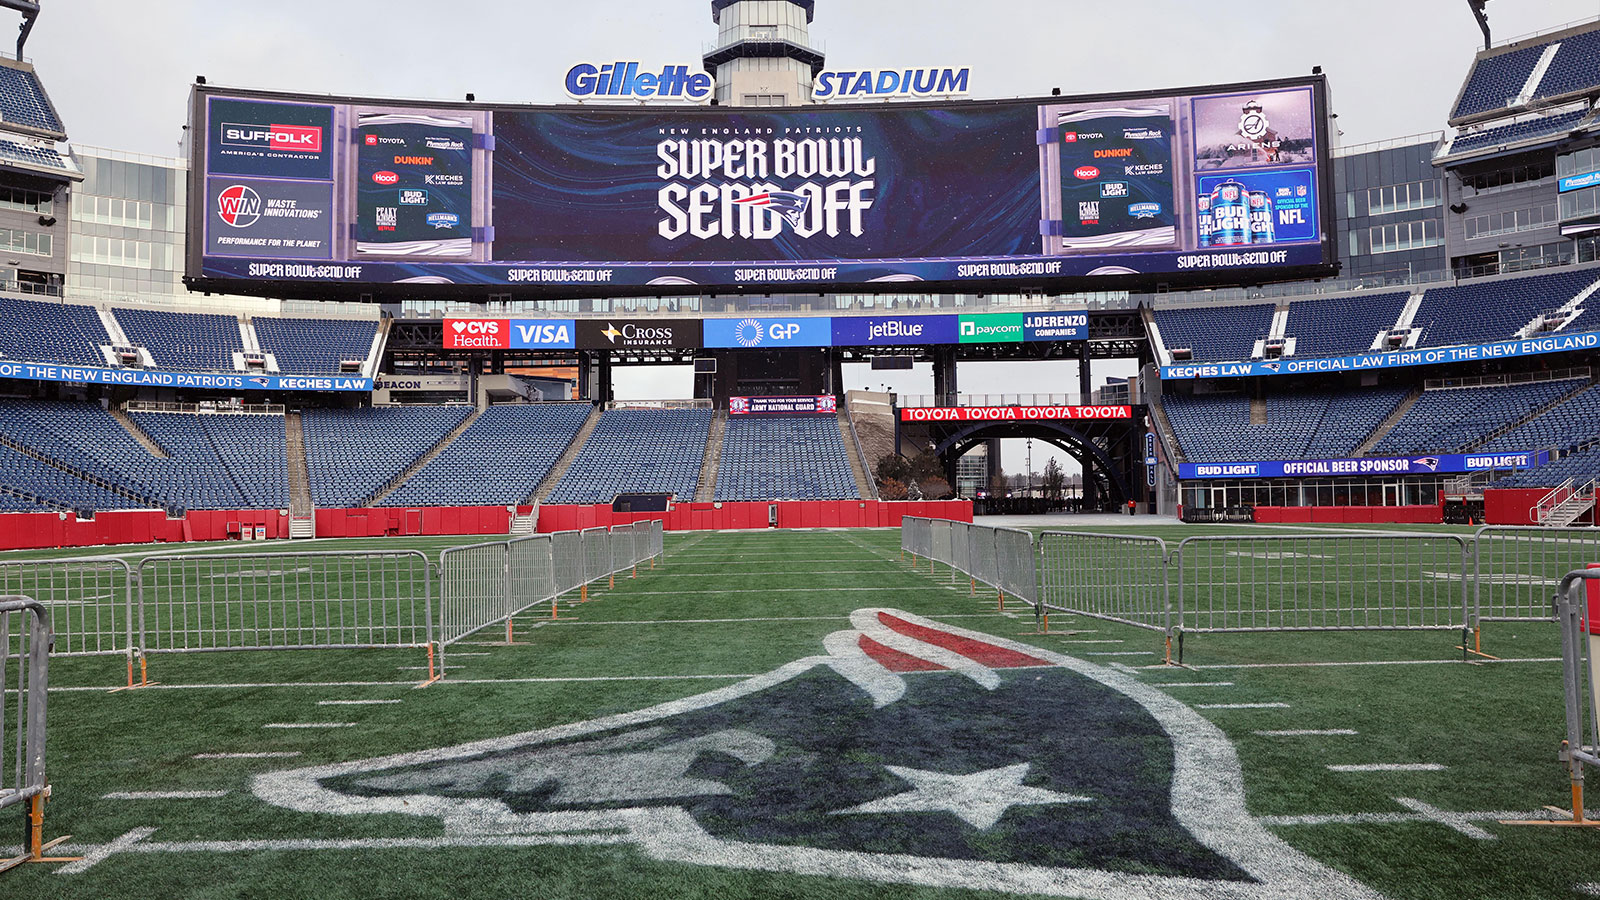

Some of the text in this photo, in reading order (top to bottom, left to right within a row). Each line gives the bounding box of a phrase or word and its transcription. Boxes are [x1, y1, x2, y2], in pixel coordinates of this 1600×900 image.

[564, 62, 970, 98] Gillette STADIUM
[226, 129, 313, 144] SUFFOLK
[702, 127, 774, 135] ENGLAND
[785, 126, 863, 134] PATRIOTS
[1077, 132, 1104, 140] TOYOTA
[378, 137, 405, 145] TOYOTA
[1227, 141, 1281, 151] ARIENS
[220, 149, 320, 160] AMERICA'S CONTRACTOR
[657, 136, 876, 180] SUPER BOWL
[1093, 148, 1133, 158] DUNKIN'
[394, 155, 434, 165] DUNKIN'
[1076, 169, 1097, 177] Hood
[1135, 163, 1163, 171] KECHES
[375, 174, 397, 182] Hood
[1102, 188, 1127, 196] LIGHT
[1224, 190, 1237, 199] NFL
[219, 197, 259, 215] WIN
[267, 199, 297, 209] WASTE
[400, 196, 426, 204] LIGHT
[263, 208, 319, 219] INNOVATIONS
[658, 178, 875, 240] SEND OFF
[1215, 205, 1247, 219] BUD
[1279, 209, 1306, 225] NFL
[1212, 217, 1249, 232] LIGHT
[217, 236, 321, 248] PERFORMANCE FOR THE PLANET
[1177, 250, 1288, 269] SUPER BOWL SEND OFF
[249, 263, 362, 279] SUPER BOWL SEND OFF
[734, 267, 837, 281] SUPER BOWL SEND OFF
[957, 261, 1062, 277] SUPER BOWL SEND OFF
[508, 269, 612, 282] SUPER BOWL SEND OFF
[469, 321, 499, 334] CVS
[1024, 315, 1087, 328] J.DERENZO
[515, 325, 570, 343] VISA
[868, 320, 923, 340] jetBlue
[976, 324, 1021, 336] paycom
[1035, 327, 1077, 337] COMPANIES
[1168, 334, 1597, 378] KECHES LAW OFFICIAL LAW FIRM OF THE NEW ENGLAND
[0, 364, 366, 389] OF THE NEW ENGLAND PATRIOTS KECHES LAW
[376, 380, 421, 389] BEACON
[795, 403, 815, 411] GUARD
[907, 406, 1127, 420] TOYOTA TOYOTA TOYOTA TOYOTA
[1283, 459, 1409, 474] OFFICIAL BEER SPONSOR
[1466, 456, 1493, 468] BUD
[1197, 464, 1257, 476] BUD LIGHT
